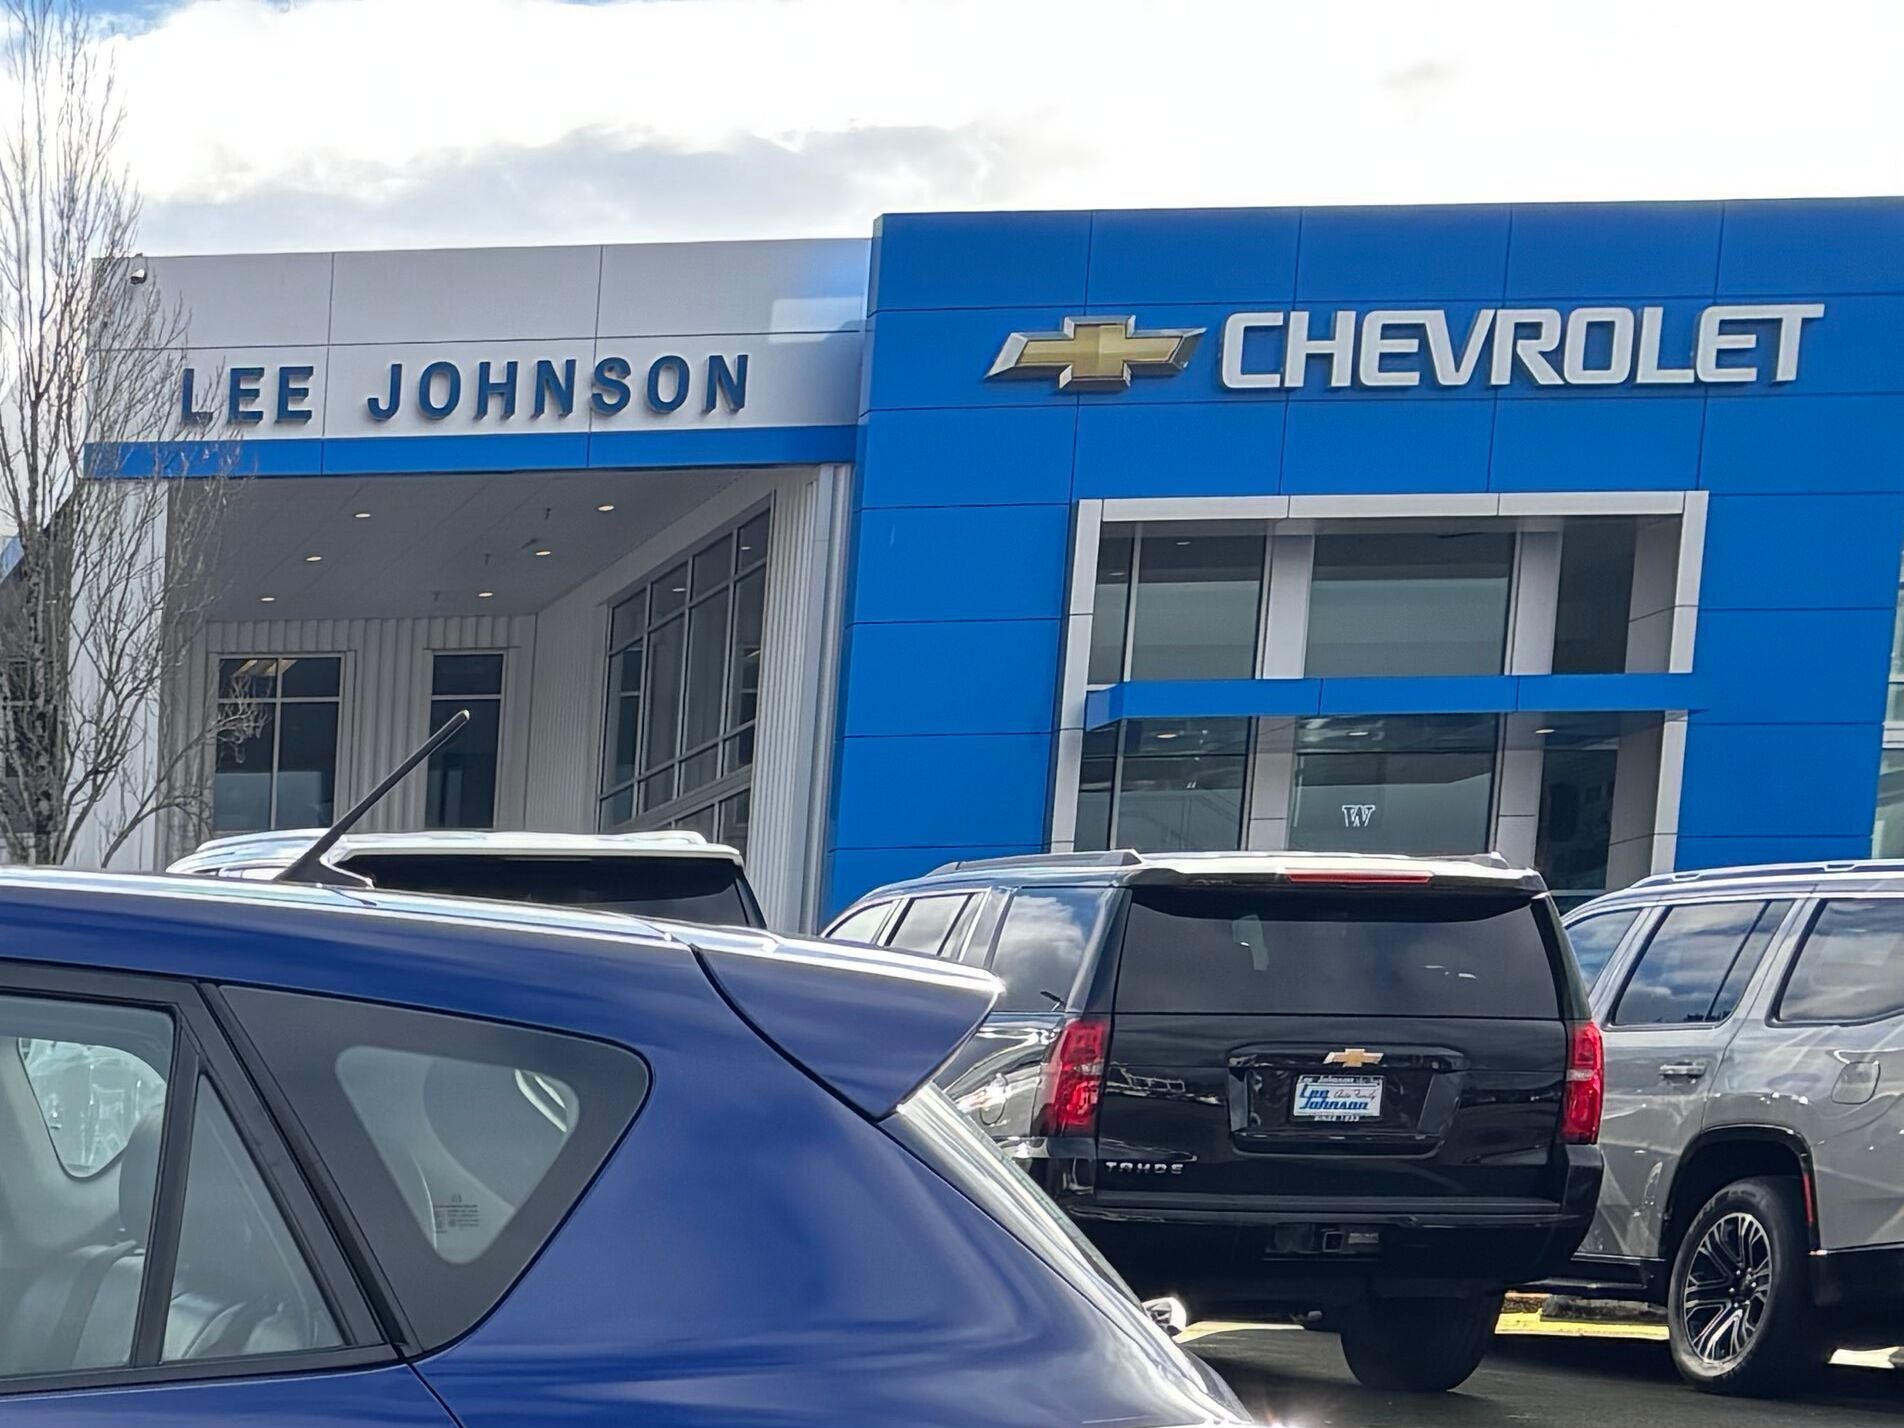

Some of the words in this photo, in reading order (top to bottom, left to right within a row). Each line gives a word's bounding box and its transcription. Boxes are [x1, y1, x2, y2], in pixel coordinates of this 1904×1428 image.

[1221, 304, 1824, 389] CHEVROLET
[181, 365, 315, 424] LEE
[367, 353, 750, 422] JOHNSON
[1299, 1084, 1330, 1099] Lee
[1299, 1097, 1370, 1110] Johnson
[1105, 1161, 1184, 1175] TAHOE
